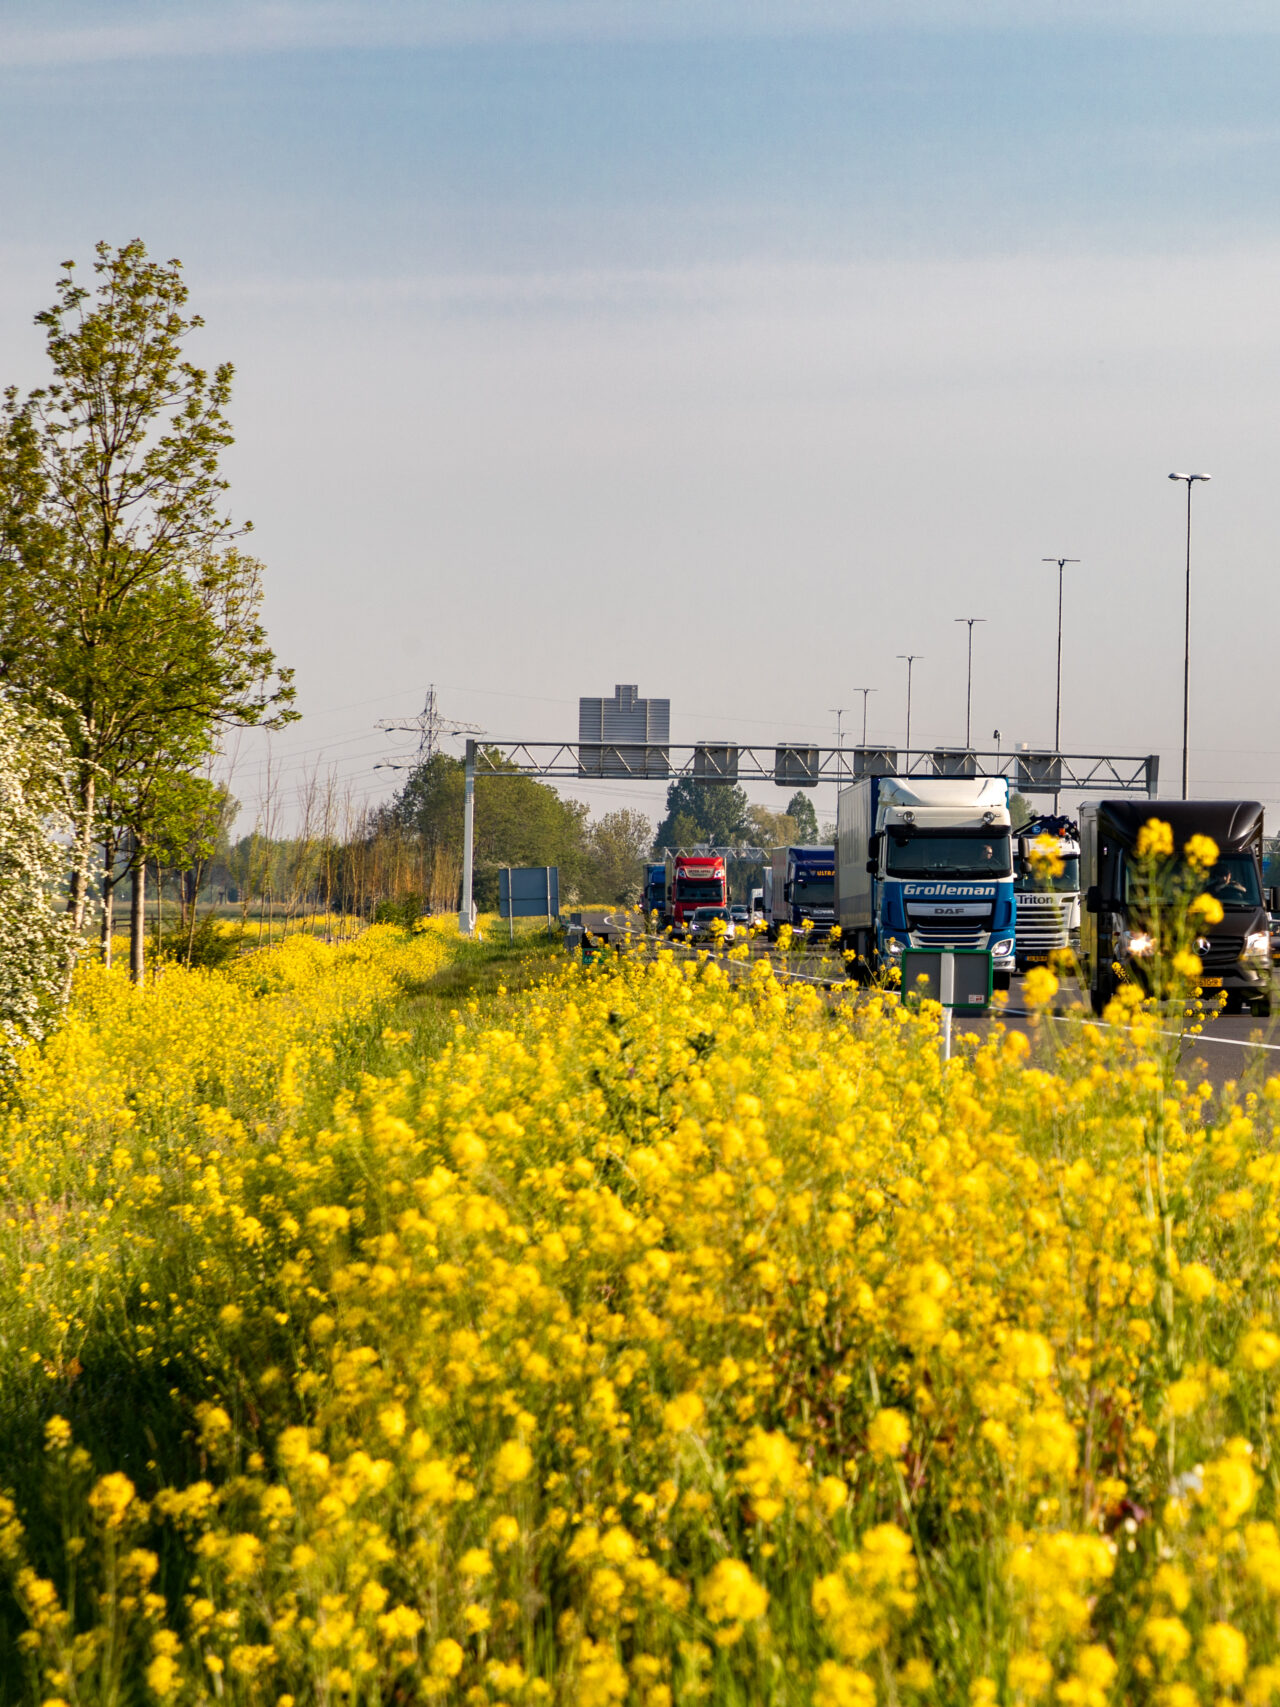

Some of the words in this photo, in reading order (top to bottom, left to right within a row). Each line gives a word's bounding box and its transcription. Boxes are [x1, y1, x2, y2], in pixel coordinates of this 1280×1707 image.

[903, 883, 996, 896] Grolleman
[1017, 894, 1054, 905] Triton
[933, 907, 965, 915] DAF
